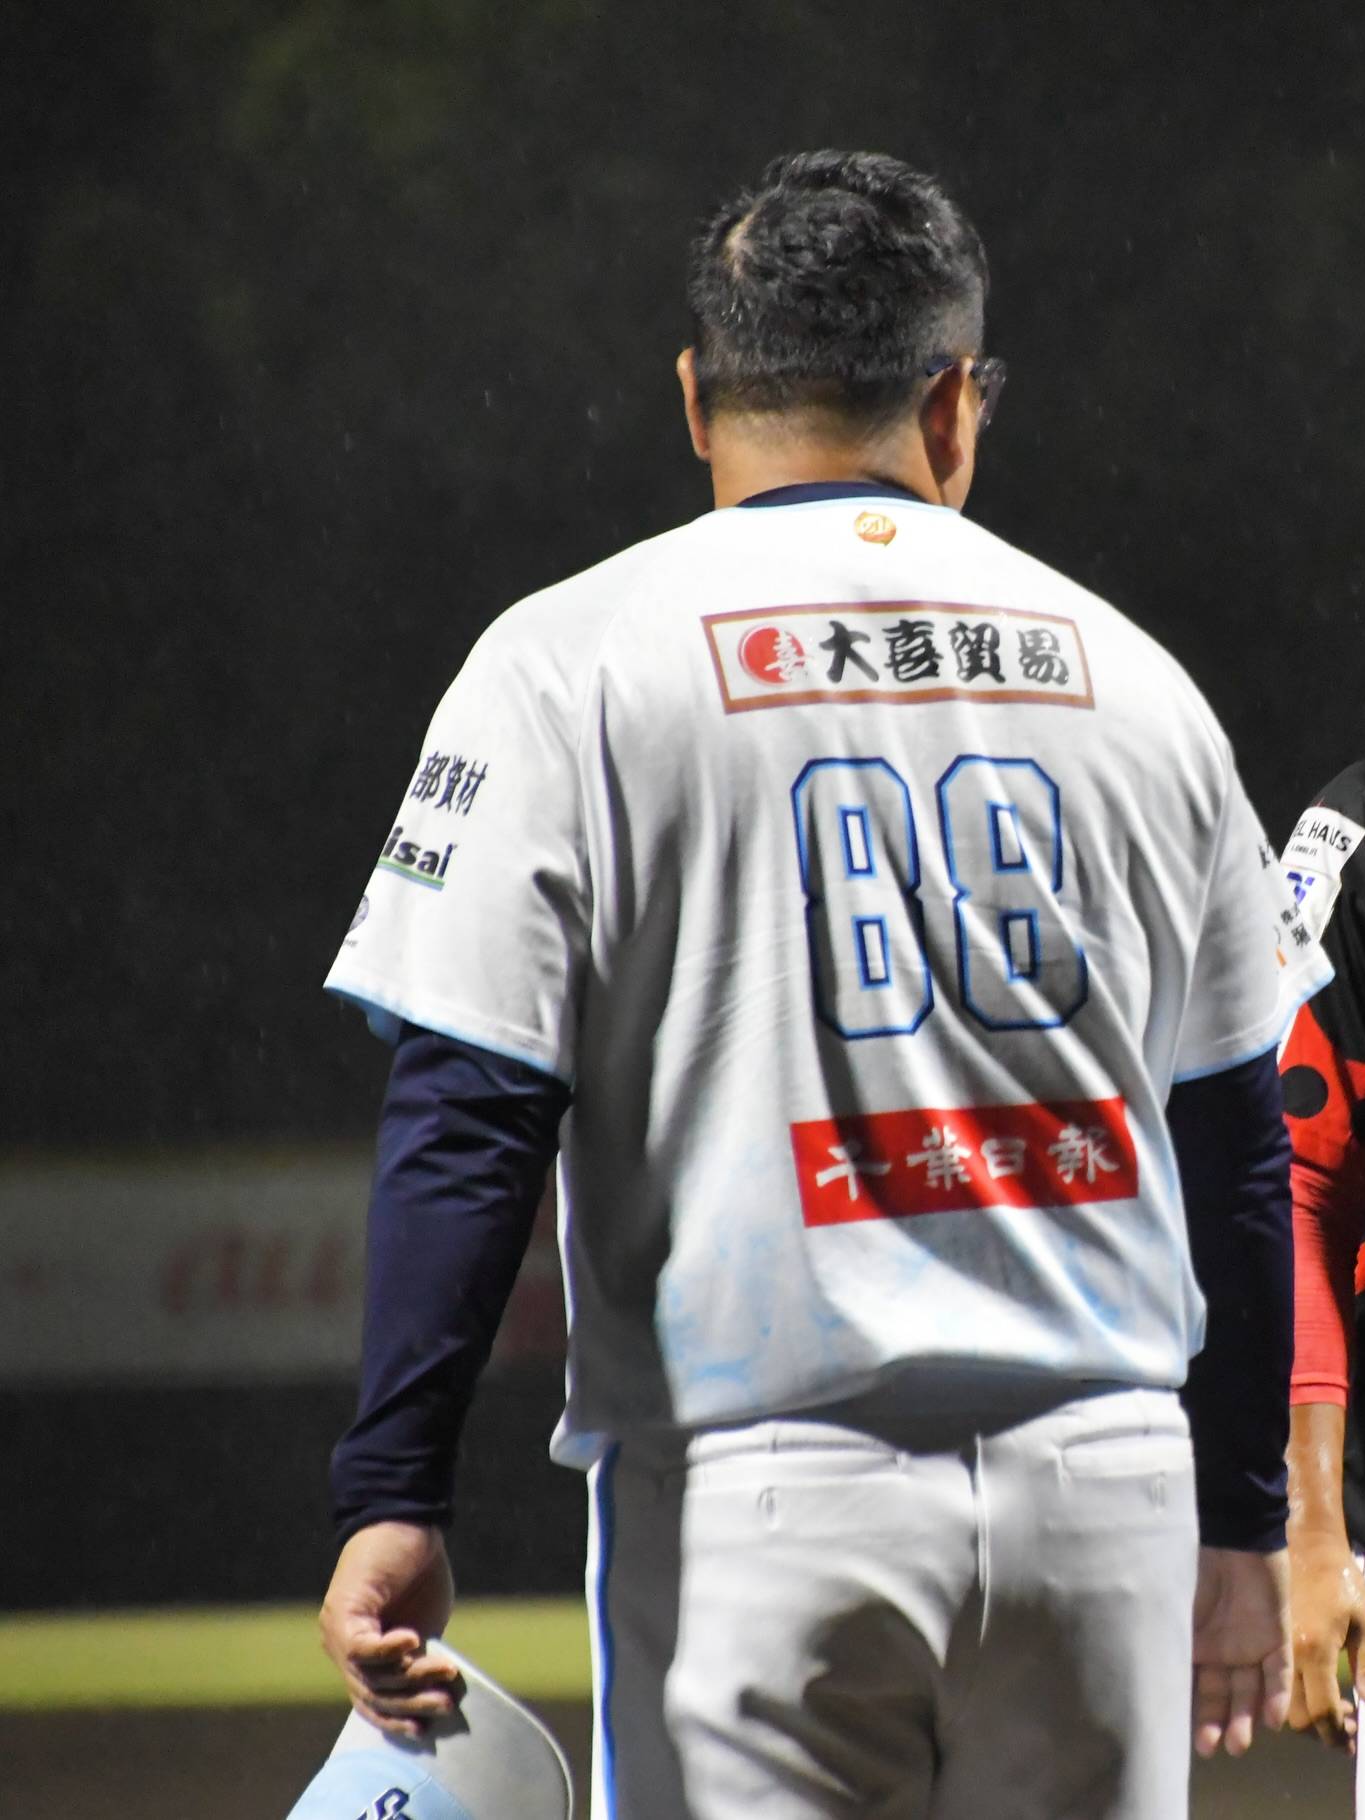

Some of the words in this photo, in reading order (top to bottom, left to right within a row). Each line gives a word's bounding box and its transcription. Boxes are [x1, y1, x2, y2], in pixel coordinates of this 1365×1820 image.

[818, 619, 1070, 686] 大喜貿易
[790, 754, 1090, 1042] 88
[815, 1123, 1121, 1203] 千葉日報
